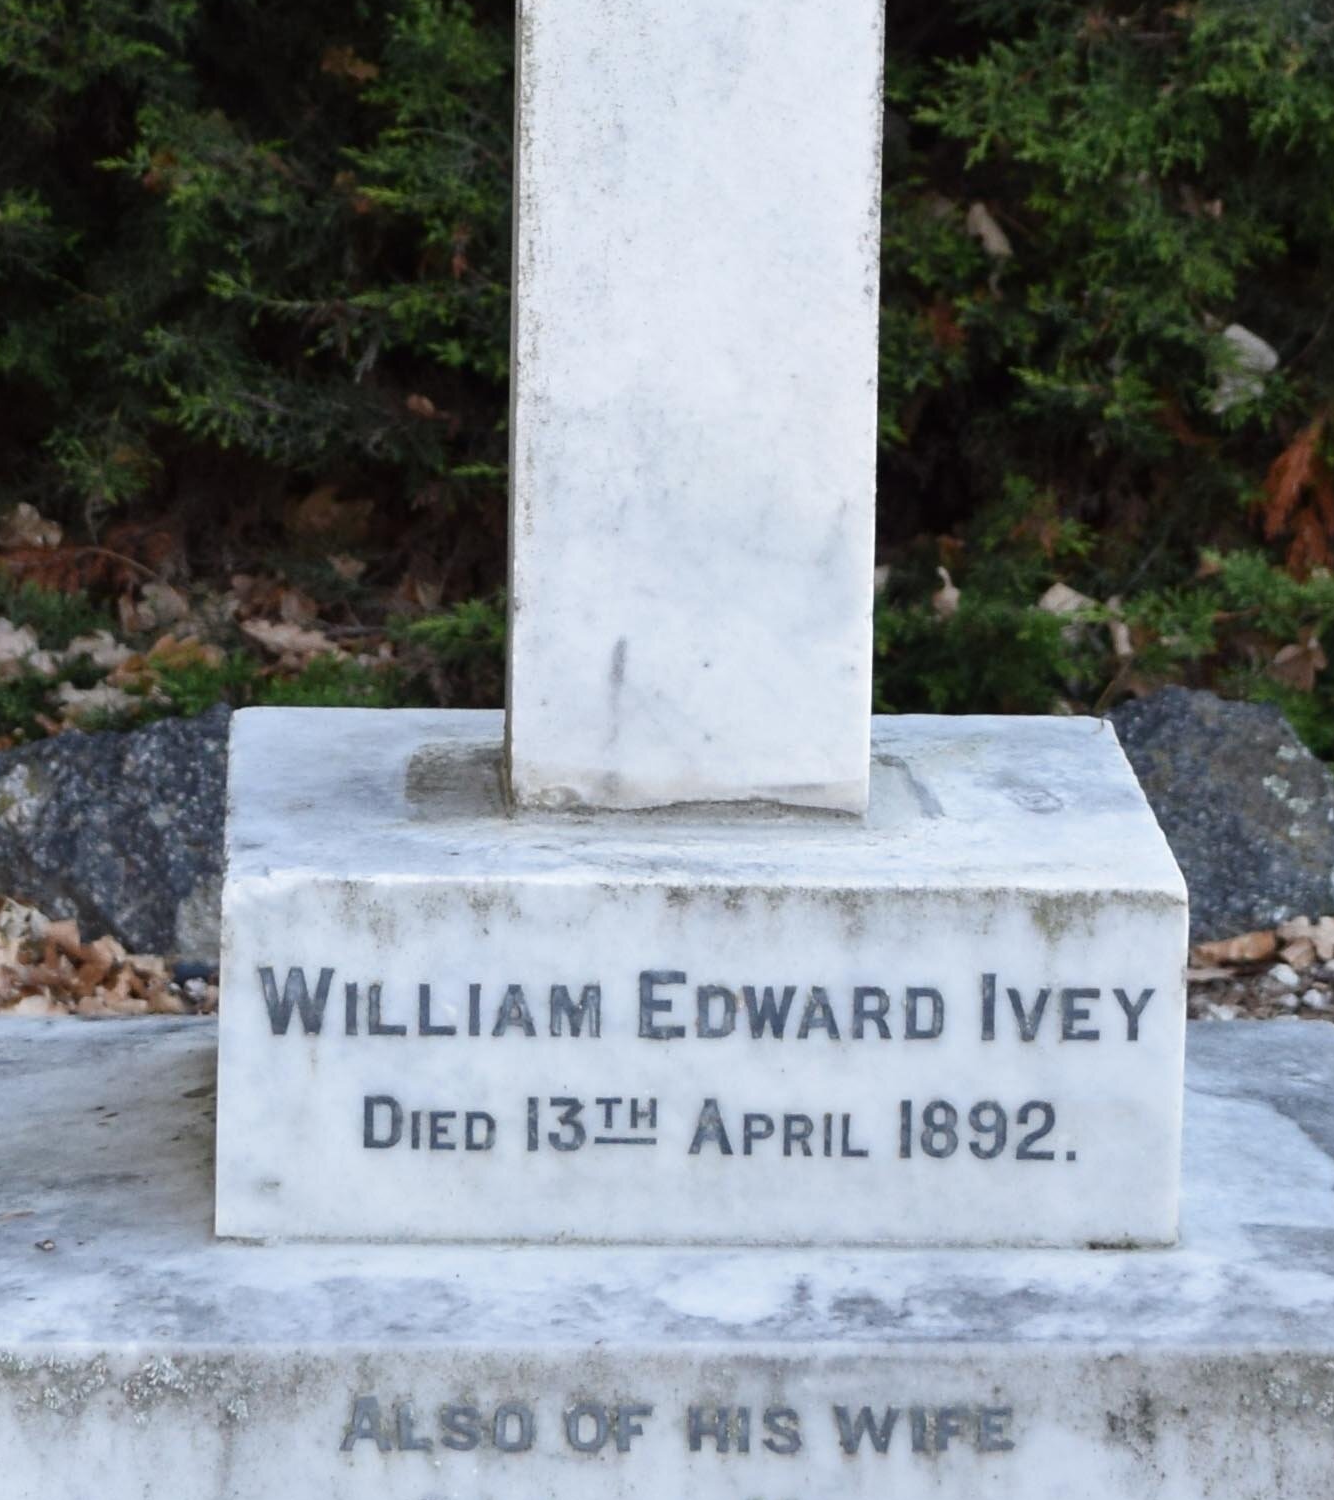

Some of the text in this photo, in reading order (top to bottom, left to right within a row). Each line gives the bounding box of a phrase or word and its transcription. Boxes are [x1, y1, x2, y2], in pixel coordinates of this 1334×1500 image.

[259, 966, 1155, 1043] WILLIAM EDWARD IVEY
[363, 1094, 1077, 1162] DIED 13TH APRIL 1892.
[339, 1396, 1015, 1454] ALSO OF HIS WIFE
